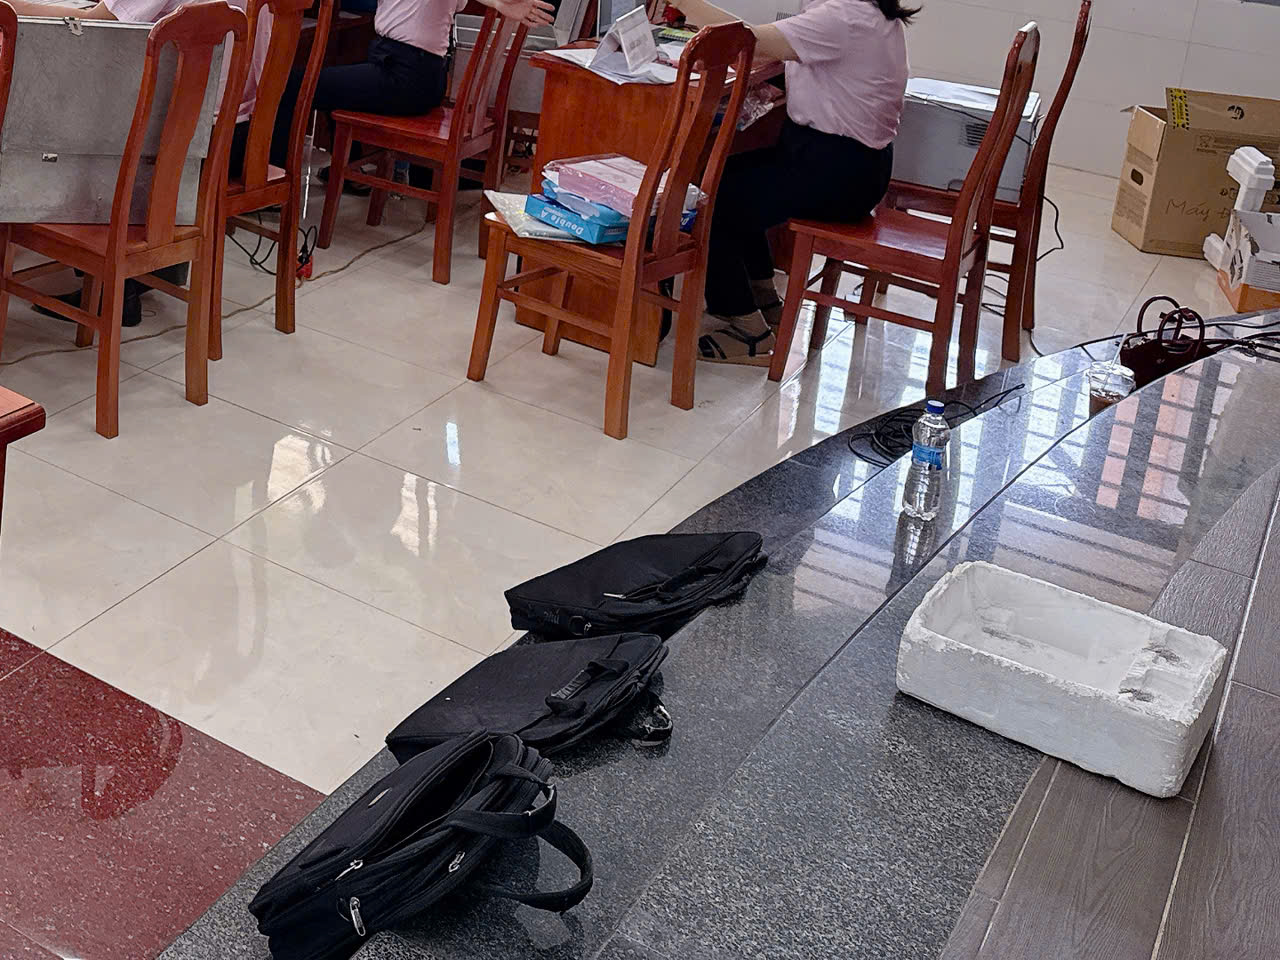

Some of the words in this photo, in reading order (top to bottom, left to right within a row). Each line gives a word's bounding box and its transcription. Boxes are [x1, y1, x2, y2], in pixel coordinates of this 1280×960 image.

[540, 209, 550, 218] A
[1164, 198, 1210, 222] Máy
[551, 213, 584, 236] Double
